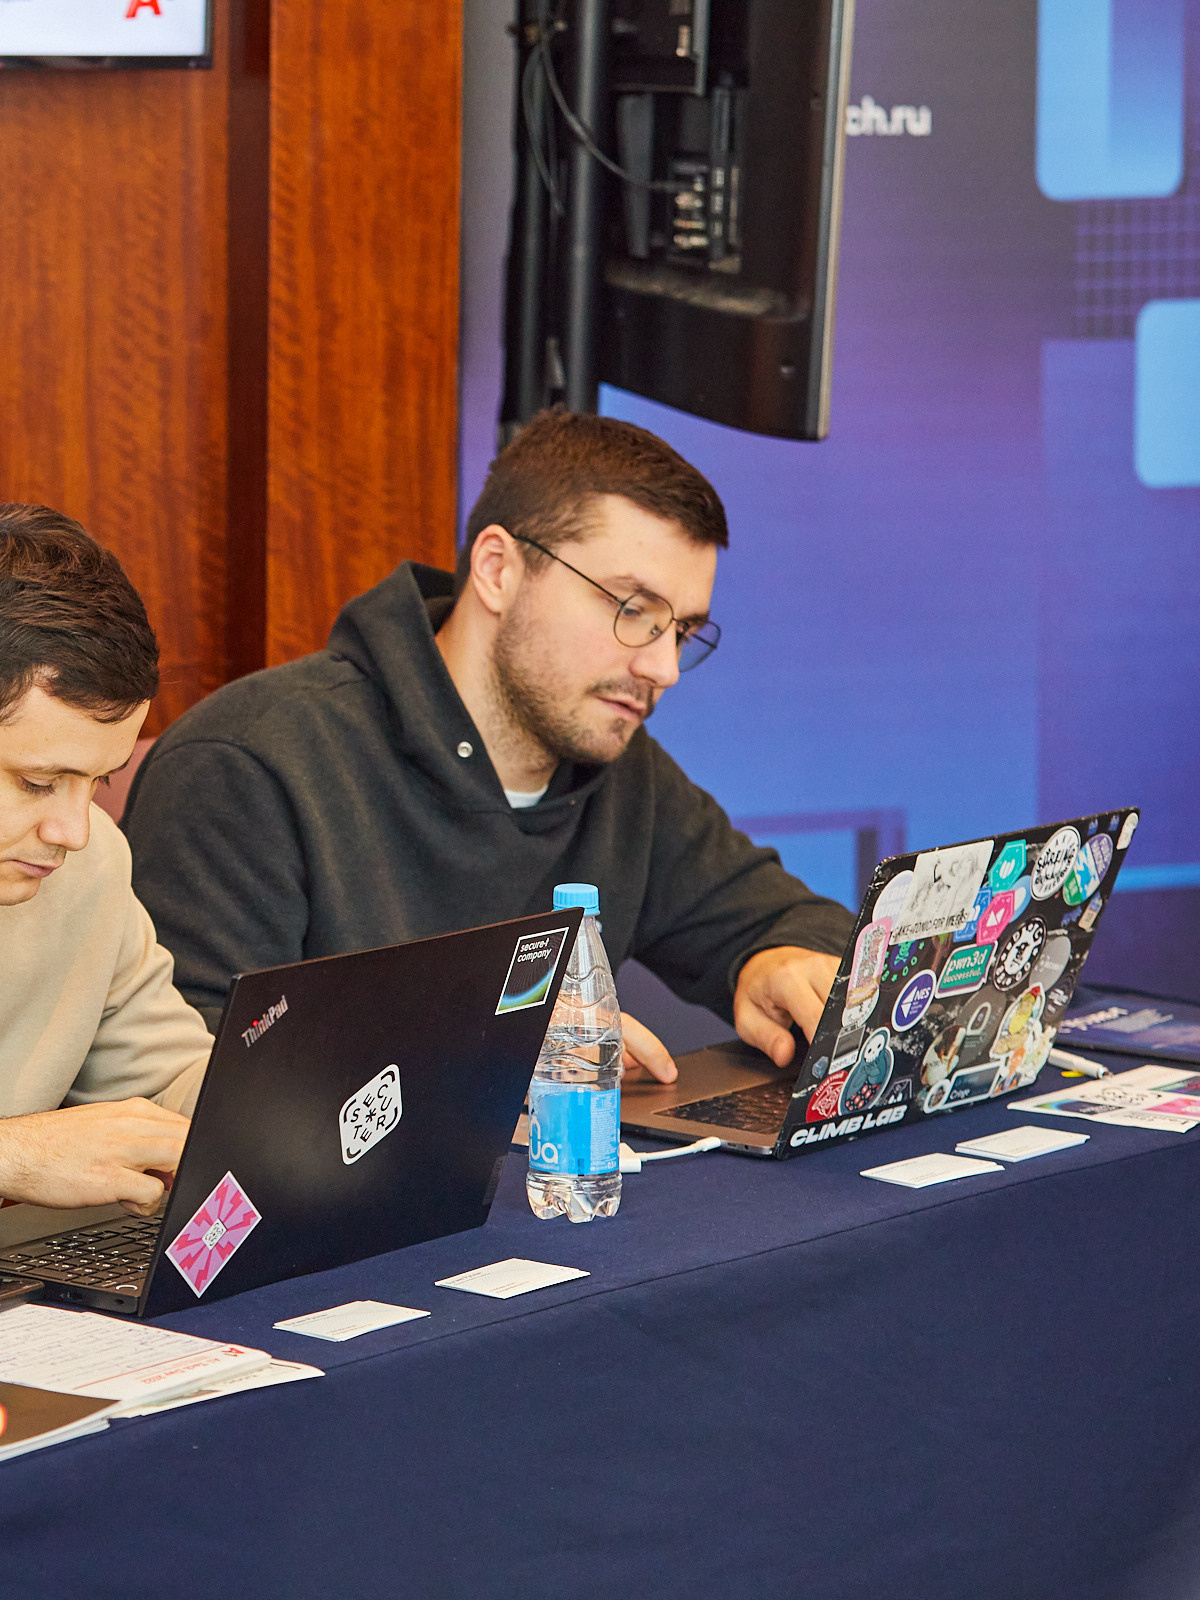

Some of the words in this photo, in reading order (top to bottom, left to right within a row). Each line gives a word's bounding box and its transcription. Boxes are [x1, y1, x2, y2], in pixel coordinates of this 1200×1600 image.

[517, 948, 552, 963] company
[948, 949, 988, 975] pwn3d
[914, 986, 931, 1001] NES
[241, 994, 289, 1048] ThinkPad
[790, 1115, 864, 1148] CLIMB
